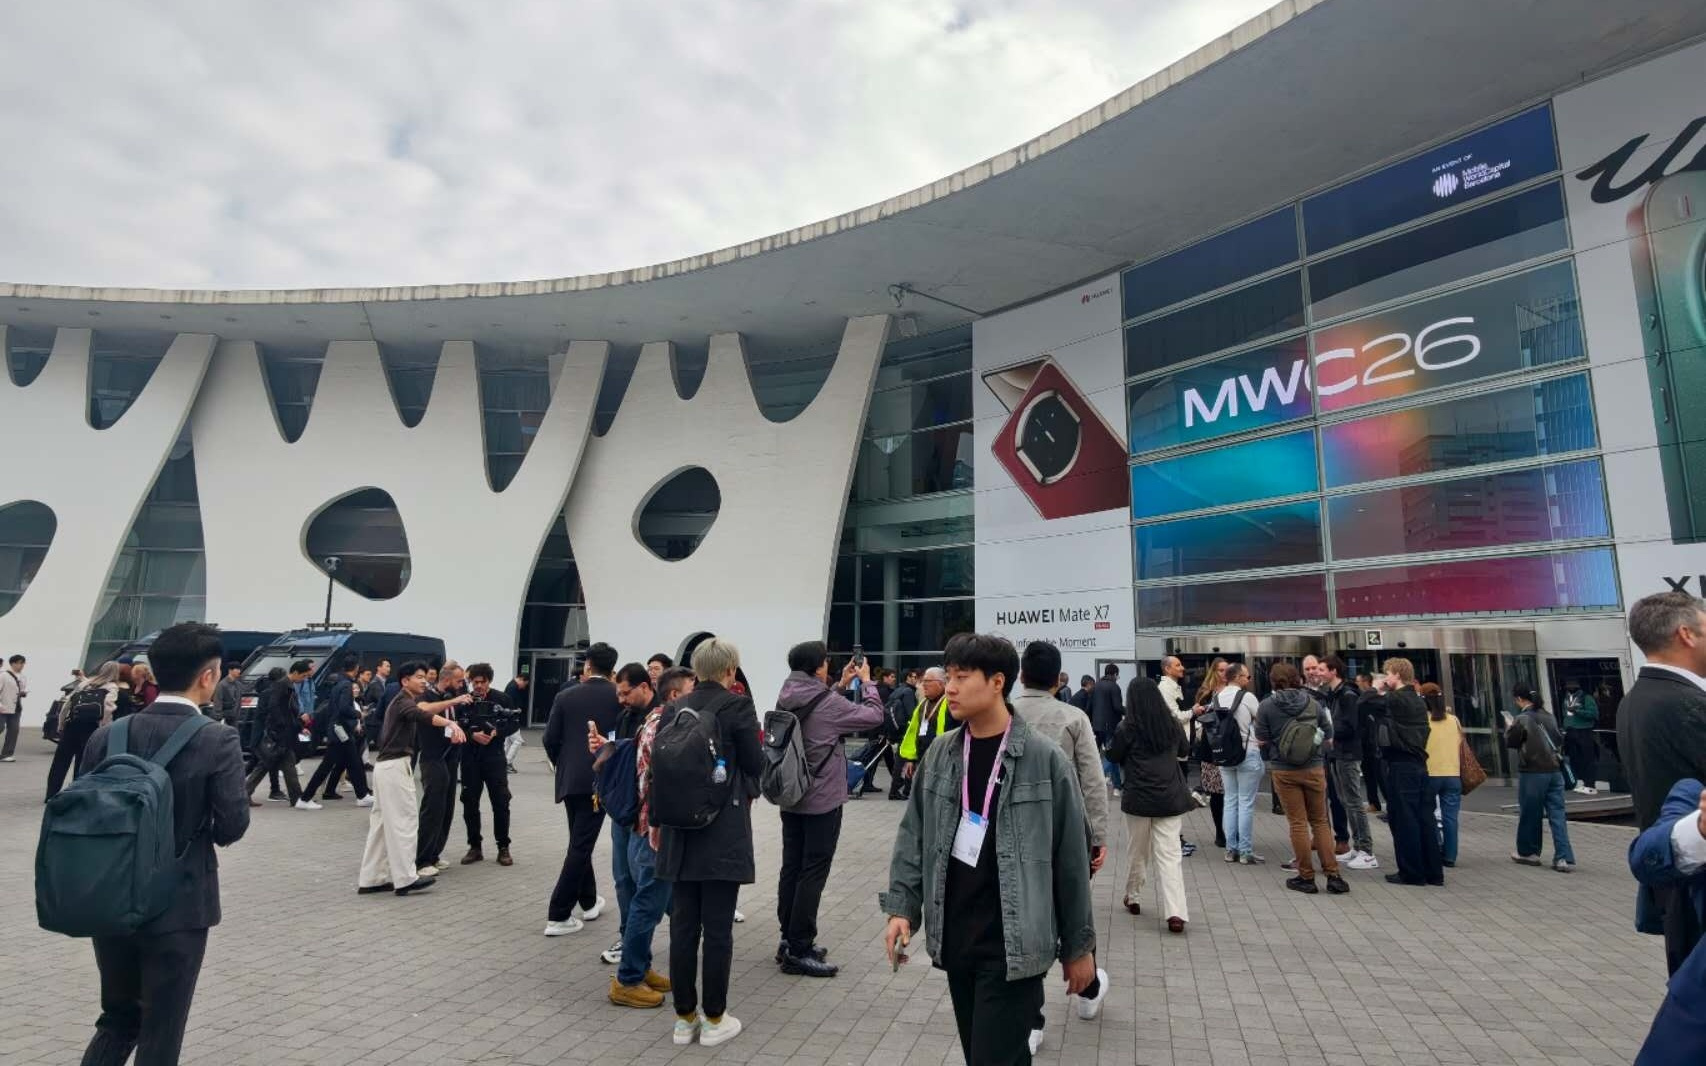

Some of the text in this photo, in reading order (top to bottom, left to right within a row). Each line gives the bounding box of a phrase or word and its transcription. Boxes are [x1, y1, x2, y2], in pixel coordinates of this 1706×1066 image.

[1183, 316, 1480, 428] MWC26
[996, 604, 1110, 625] HUAWEI Mate X7
[1060, 637, 1097, 647] Moment
